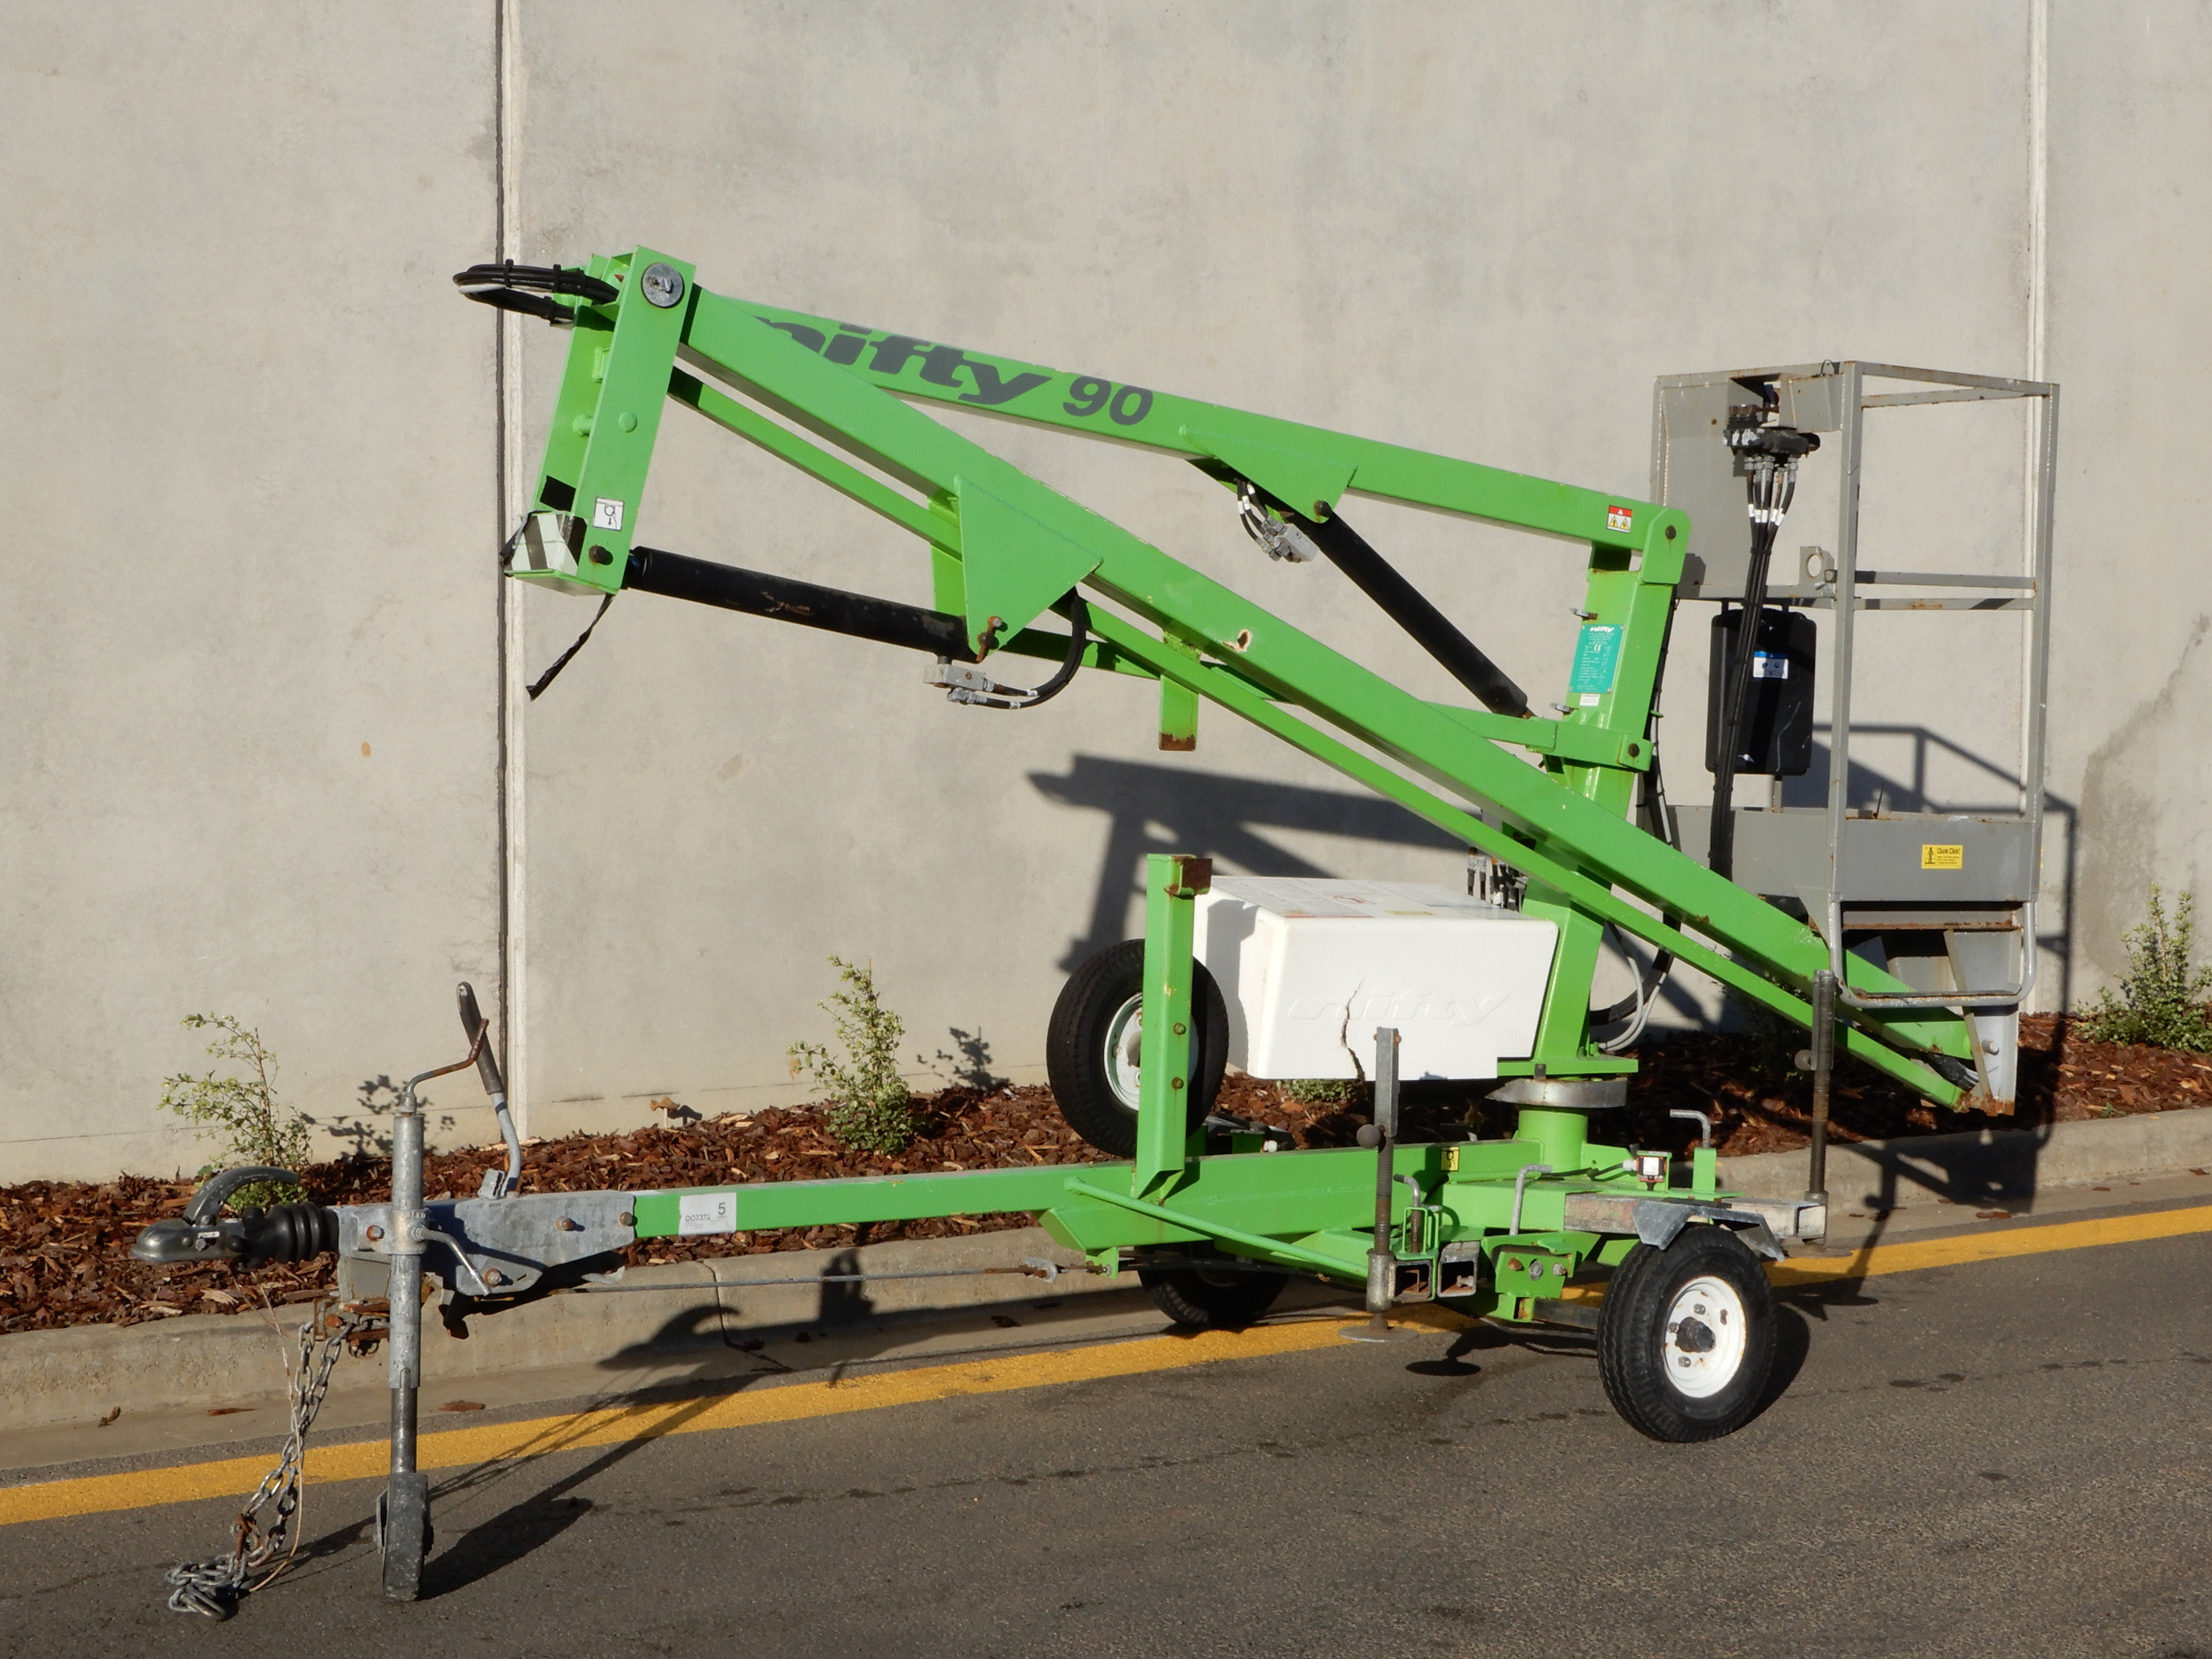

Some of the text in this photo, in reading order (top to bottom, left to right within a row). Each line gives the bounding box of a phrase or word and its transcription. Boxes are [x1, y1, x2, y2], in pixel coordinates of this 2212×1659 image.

[1062, 375, 1154, 426] 90
[1589, 625, 1614, 633] nifty
[1287, 988, 1510, 1027] nifty
[717, 1201, 726, 1216] 5
